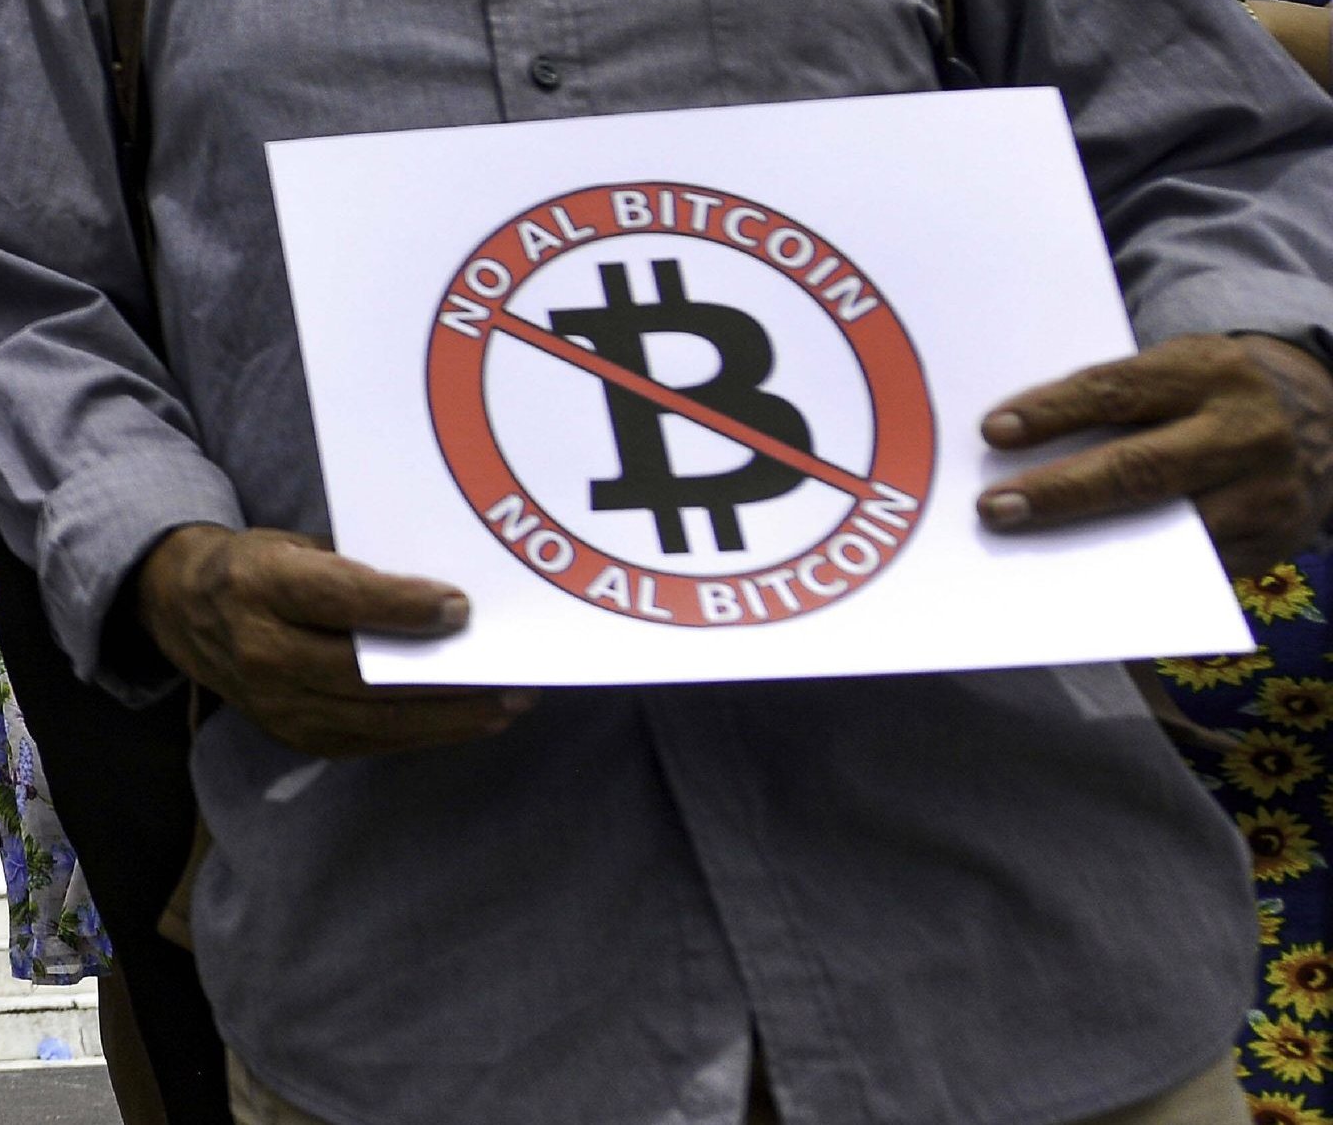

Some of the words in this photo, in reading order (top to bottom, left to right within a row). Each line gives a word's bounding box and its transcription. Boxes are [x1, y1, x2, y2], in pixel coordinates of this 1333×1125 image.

[438, 257, 511, 339] NO
[516, 205, 596, 261] AL
[610, 190, 879, 323] BITCOIN
[484, 494, 574, 574] NO
[585, 565, 672, 620] AL
[698, 481, 919, 624] BITCOIN
